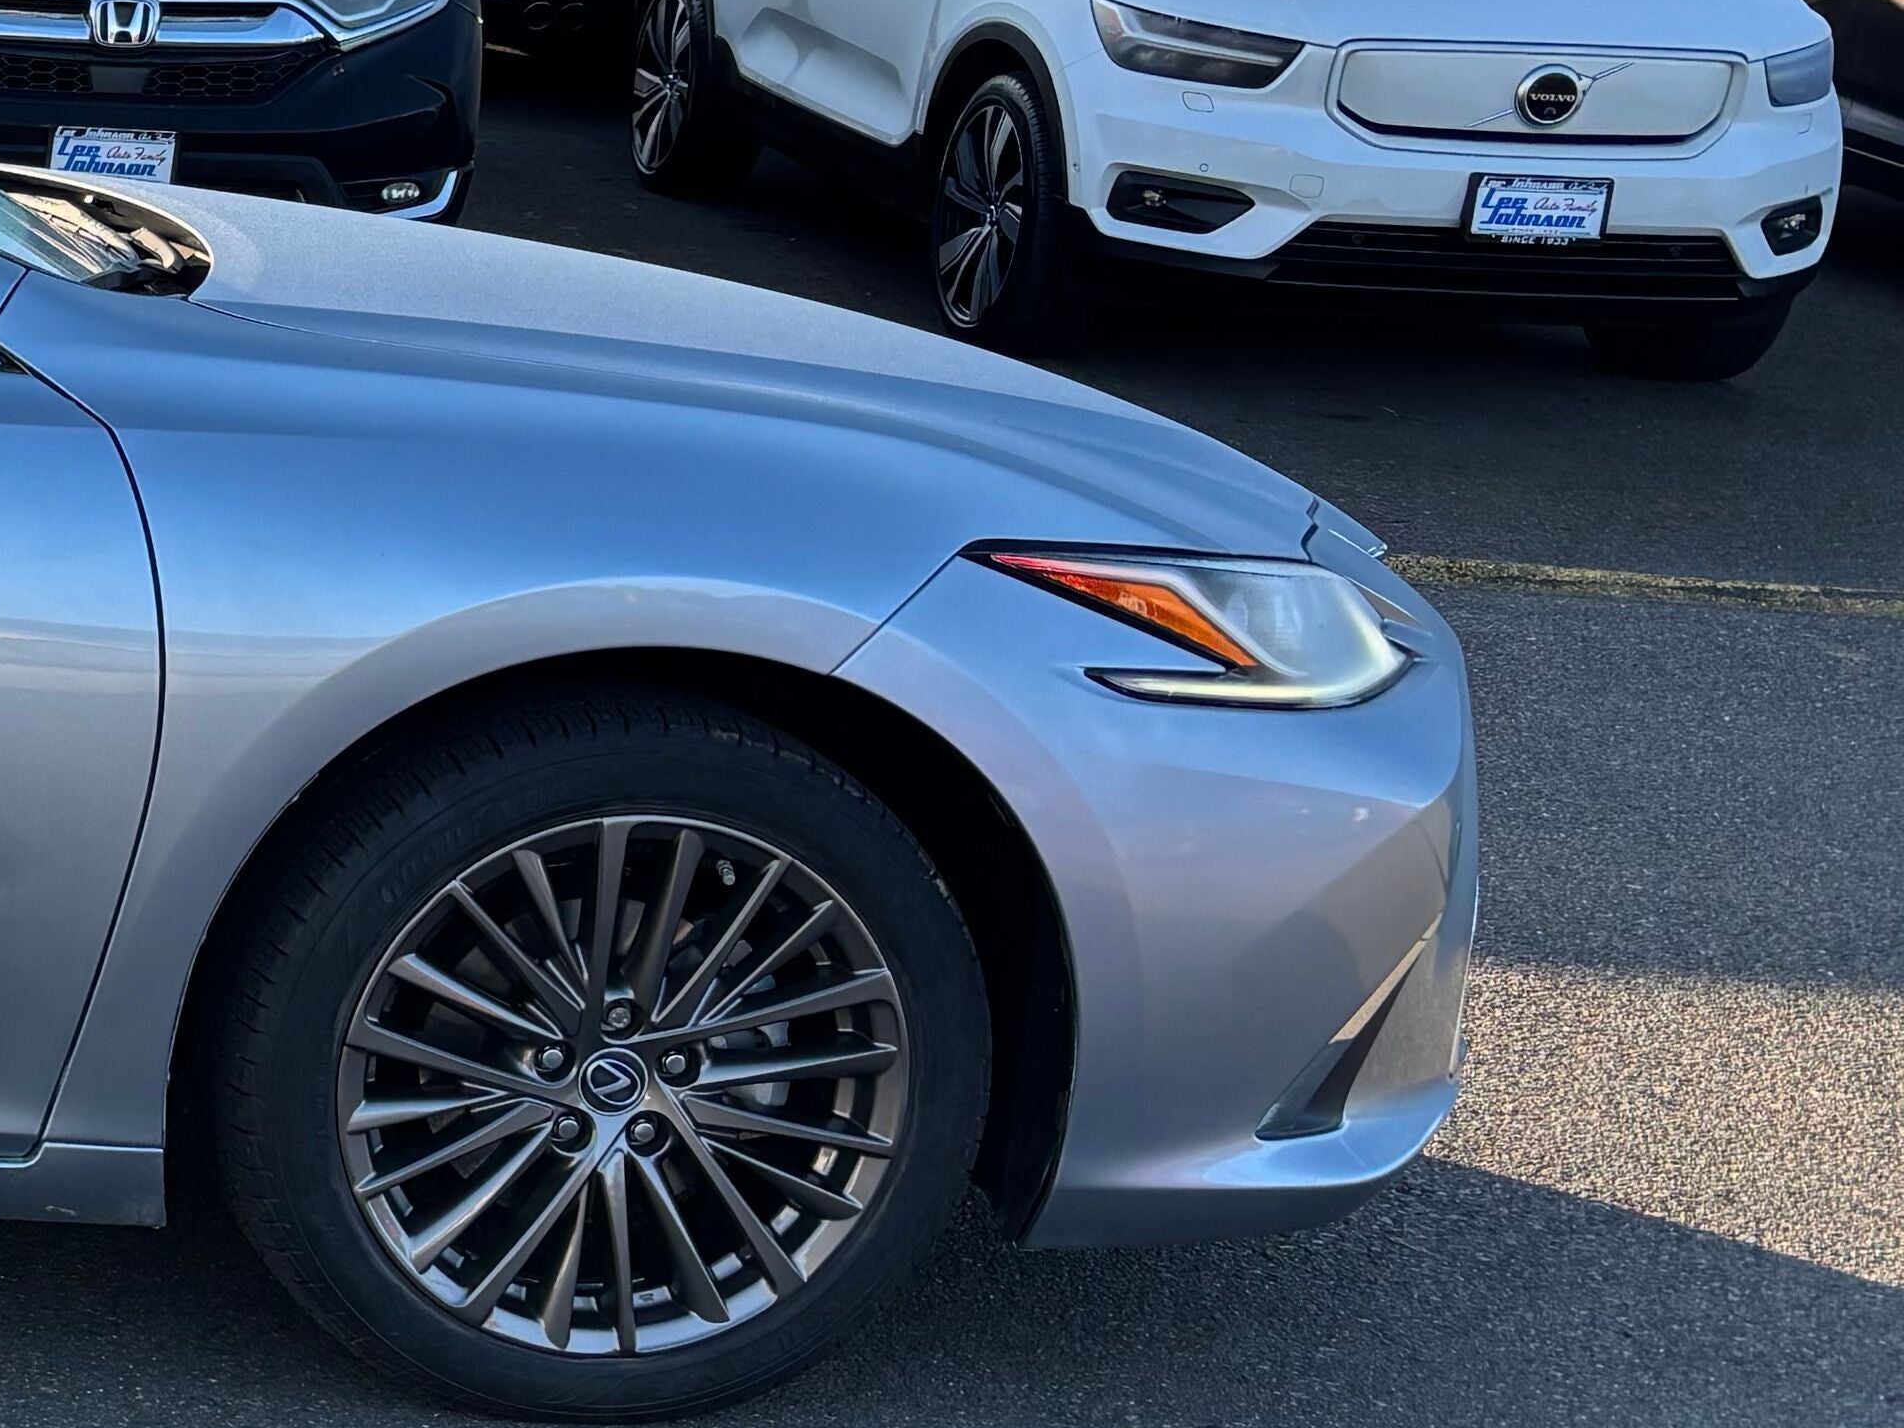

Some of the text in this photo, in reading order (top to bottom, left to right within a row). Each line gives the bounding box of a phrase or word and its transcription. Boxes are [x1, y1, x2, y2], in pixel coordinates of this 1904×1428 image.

[1530, 92, 1576, 103] VOLVO
[57, 136, 101, 158] Lee
[57, 153, 157, 177] Johnson
[1481, 187, 1528, 209] Lee
[1479, 205, 1586, 229] Johnson
